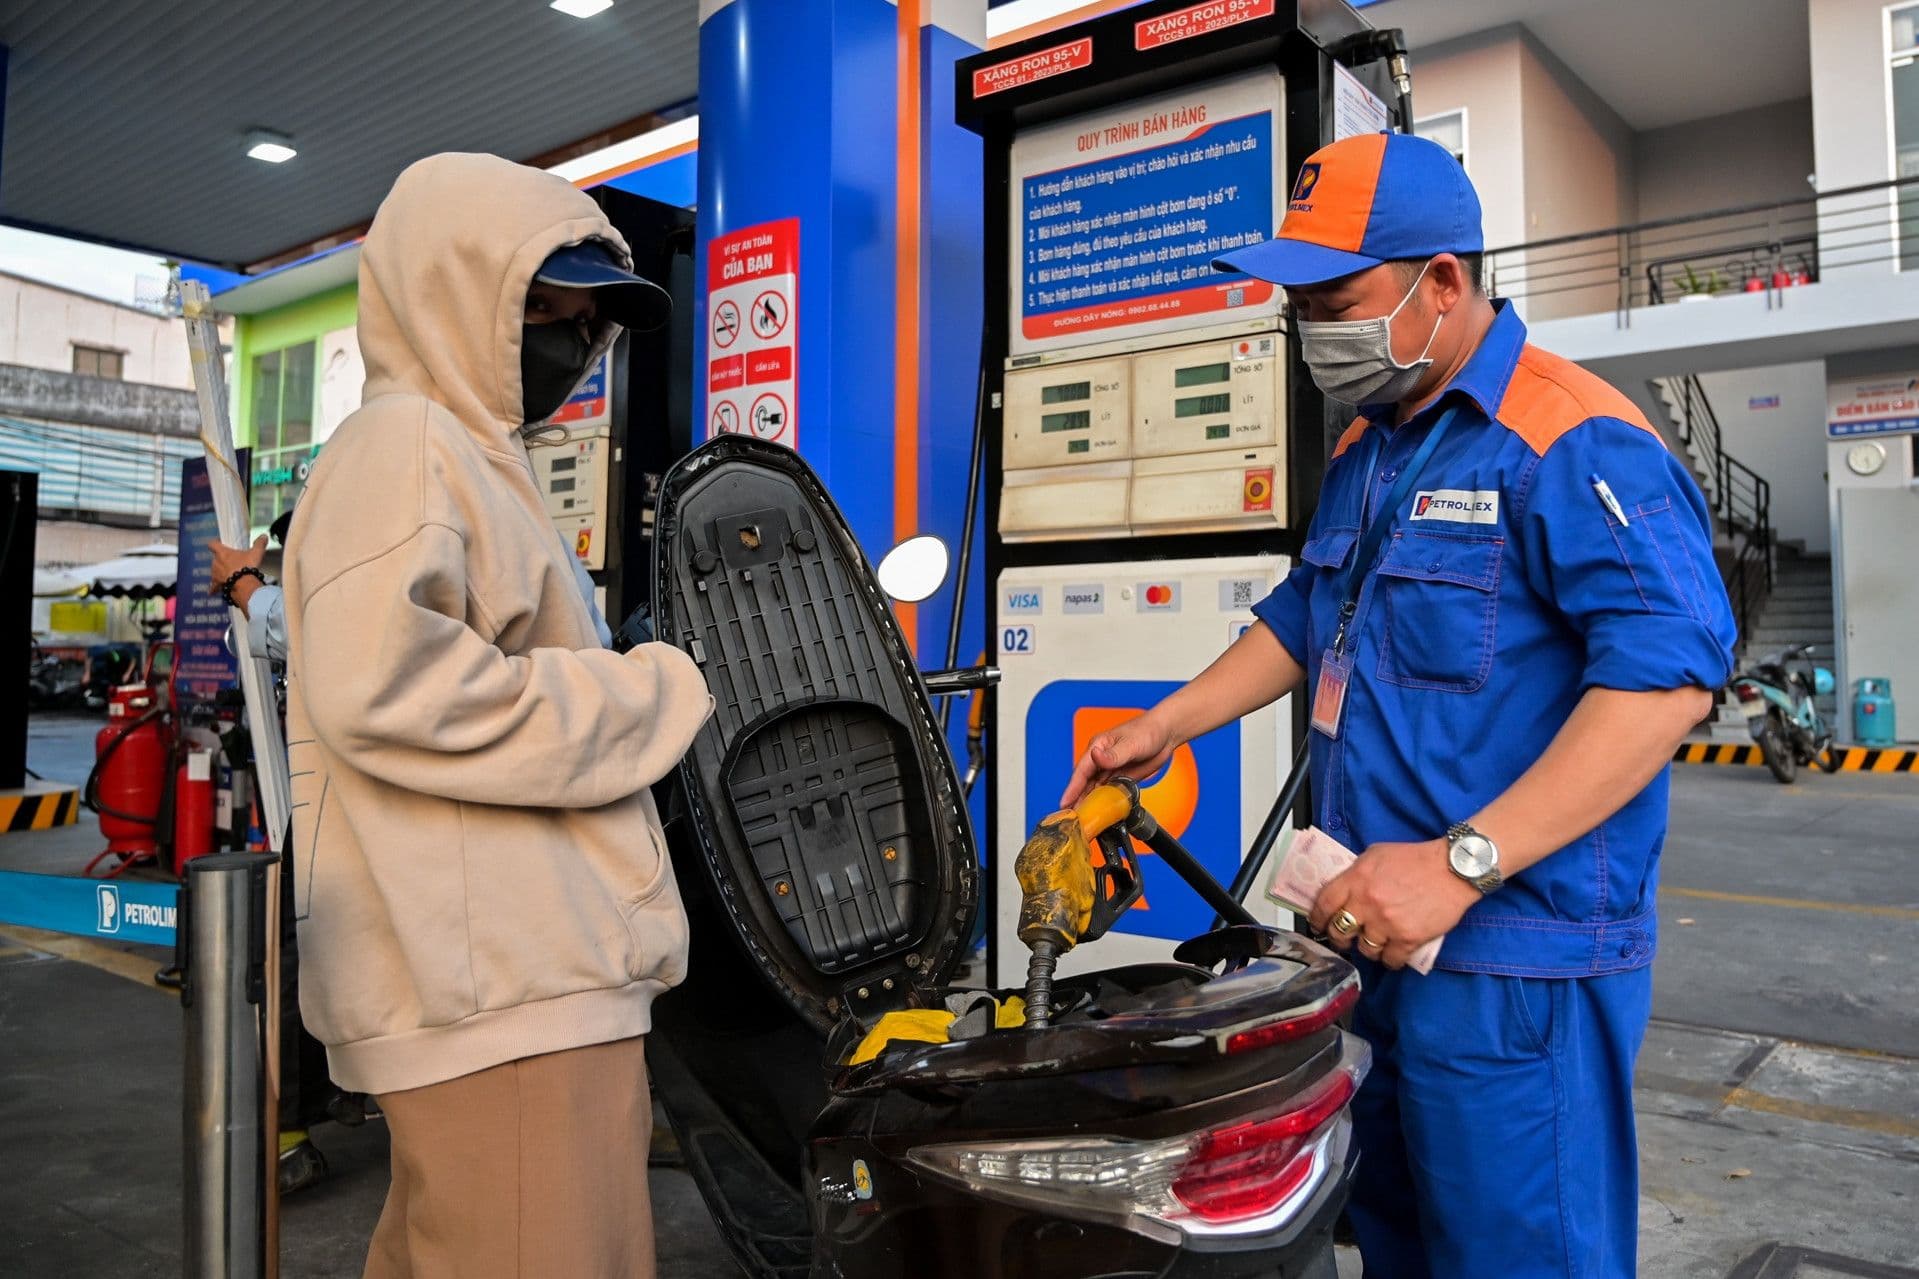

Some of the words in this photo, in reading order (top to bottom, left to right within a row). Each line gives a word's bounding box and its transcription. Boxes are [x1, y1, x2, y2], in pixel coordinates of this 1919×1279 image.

[1146, 15, 1189, 37] XĂNG
[1192, 6, 1225, 26] RON
[1158, 29, 1184, 43] TCCS
[1185, 26, 1198, 37] 01
[1205, 10, 1250, 31] 2023/PLX
[983, 63, 1019, 84] XĂNG
[1021, 56, 1050, 75] RON
[1053, 45, 1083, 66] 95-V
[993, 76, 1016, 90] TCCS
[1077, 130, 1102, 152] QUY
[1104, 122, 1139, 146] TRÌNH
[1143, 113, 1168, 136] BÁN
[1172, 105, 1206, 130] HÀNG
[1074, 172, 1096, 189] khách
[1096, 169, 1115, 185] hàng
[1115, 164, 1128, 179] vào
[1128, 162, 1137, 179] vị
[1148, 156, 1166, 173] chào
[1179, 150, 1190, 165] và
[1190, 147, 1204, 163] xác
[1205, 143, 1225, 161] nhận
[1225, 140, 1241, 154] nhu
[1242, 133, 1257, 151] cầu
[1029, 206, 1042, 221] của
[1042, 201, 1063, 218] khách
[1029, 228, 1036, 242] 2.
[1051, 221, 1072, 238] khách
[1072, 219, 1090, 234] hàng
[1090, 214, 1103, 229] xác
[1104, 211, 1122, 228] nhận
[1122, 207, 1139, 222] màn
[1139, 202, 1156, 219] hình
[1157, 200, 1169, 218] cột
[1169, 199, 1186, 213] bơm
[1187, 195, 1206, 211] đang
[1213, 187, 1224, 203] số
[731, 242, 741, 255] SỰ
[741, 240, 752, 251] AN
[752, 234, 773, 249] TOÀN
[1038, 248, 1054, 262] Bơm
[1054, 244, 1072, 260] hàng
[1103, 233, 1120, 249] theo
[1119, 231, 1133, 249] yêu
[1133, 227, 1147, 243] cầu
[1148, 223, 1162, 240] của
[1163, 220, 1185, 236] khách
[1187, 217, 1208, 234] hàng.
[1051, 265, 1072, 281] khách
[1072, 263, 1090, 278] hàng
[1090, 259, 1103, 274] xác
[1104, 255, 1122, 273] nhận
[1122, 252, 1139, 267] màn
[1139, 248, 1156, 264] hình
[1157, 246, 1169, 264] cột
[1169, 245, 1186, 259] bơm
[1187, 241, 1207, 256] trước
[1208, 236, 1220, 252] khi
[1221, 232, 1244, 250] thanh
[1245, 229, 1264, 245] toán.
[723, 257, 745, 280] CỦA
[747, 252, 773, 275] BẠN
[1038, 291, 1055, 307] Thực
[1055, 287, 1071, 304] hiện
[1071, 283, 1091, 299] thanh
[1091, 280, 1108, 296] toán
[1108, 279, 1117, 292] và
[1118, 276, 1131, 291] xác
[1131, 273, 1150, 291] nhận
[1151, 268, 1163, 286] kết
[1163, 266, 1180, 287] quả,
[1181, 264, 1197, 280] cảm
[1198, 264, 1208, 277] ơn
[1242, 394, 1254, 404] LÍT
[1008, 594, 1040, 609] VISA
[1064, 593, 1092, 607] napas
[1003, 628, 1029, 652] 02
